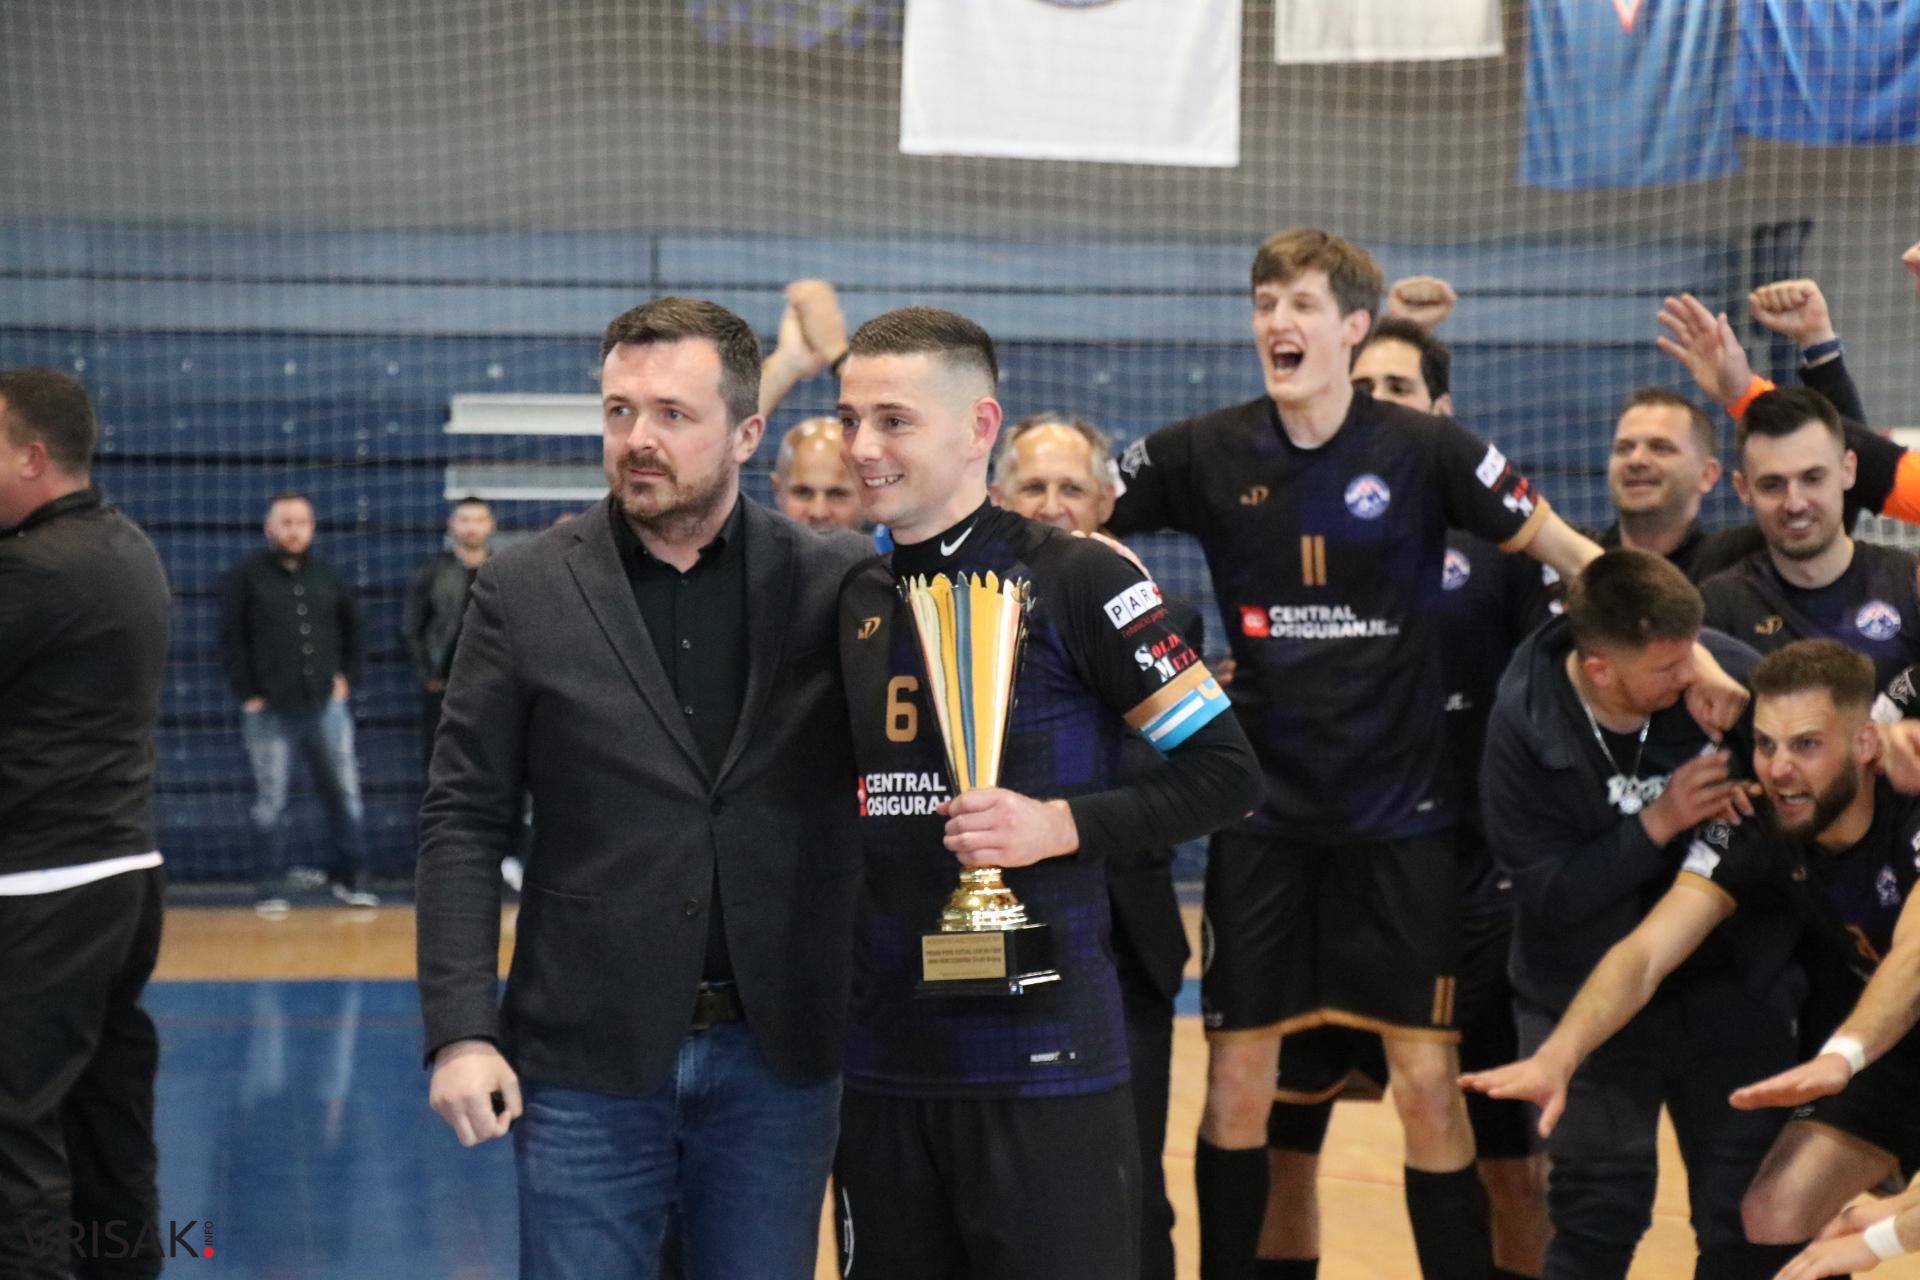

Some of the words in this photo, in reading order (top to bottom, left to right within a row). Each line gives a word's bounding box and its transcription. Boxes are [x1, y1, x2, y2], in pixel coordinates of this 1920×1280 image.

[1269, 604, 1357, 622] CENTRAL
[886, 675, 919, 743] 6
[865, 772, 947, 794] CENTRAL
[866, 795, 952, 817] OSIGURA
